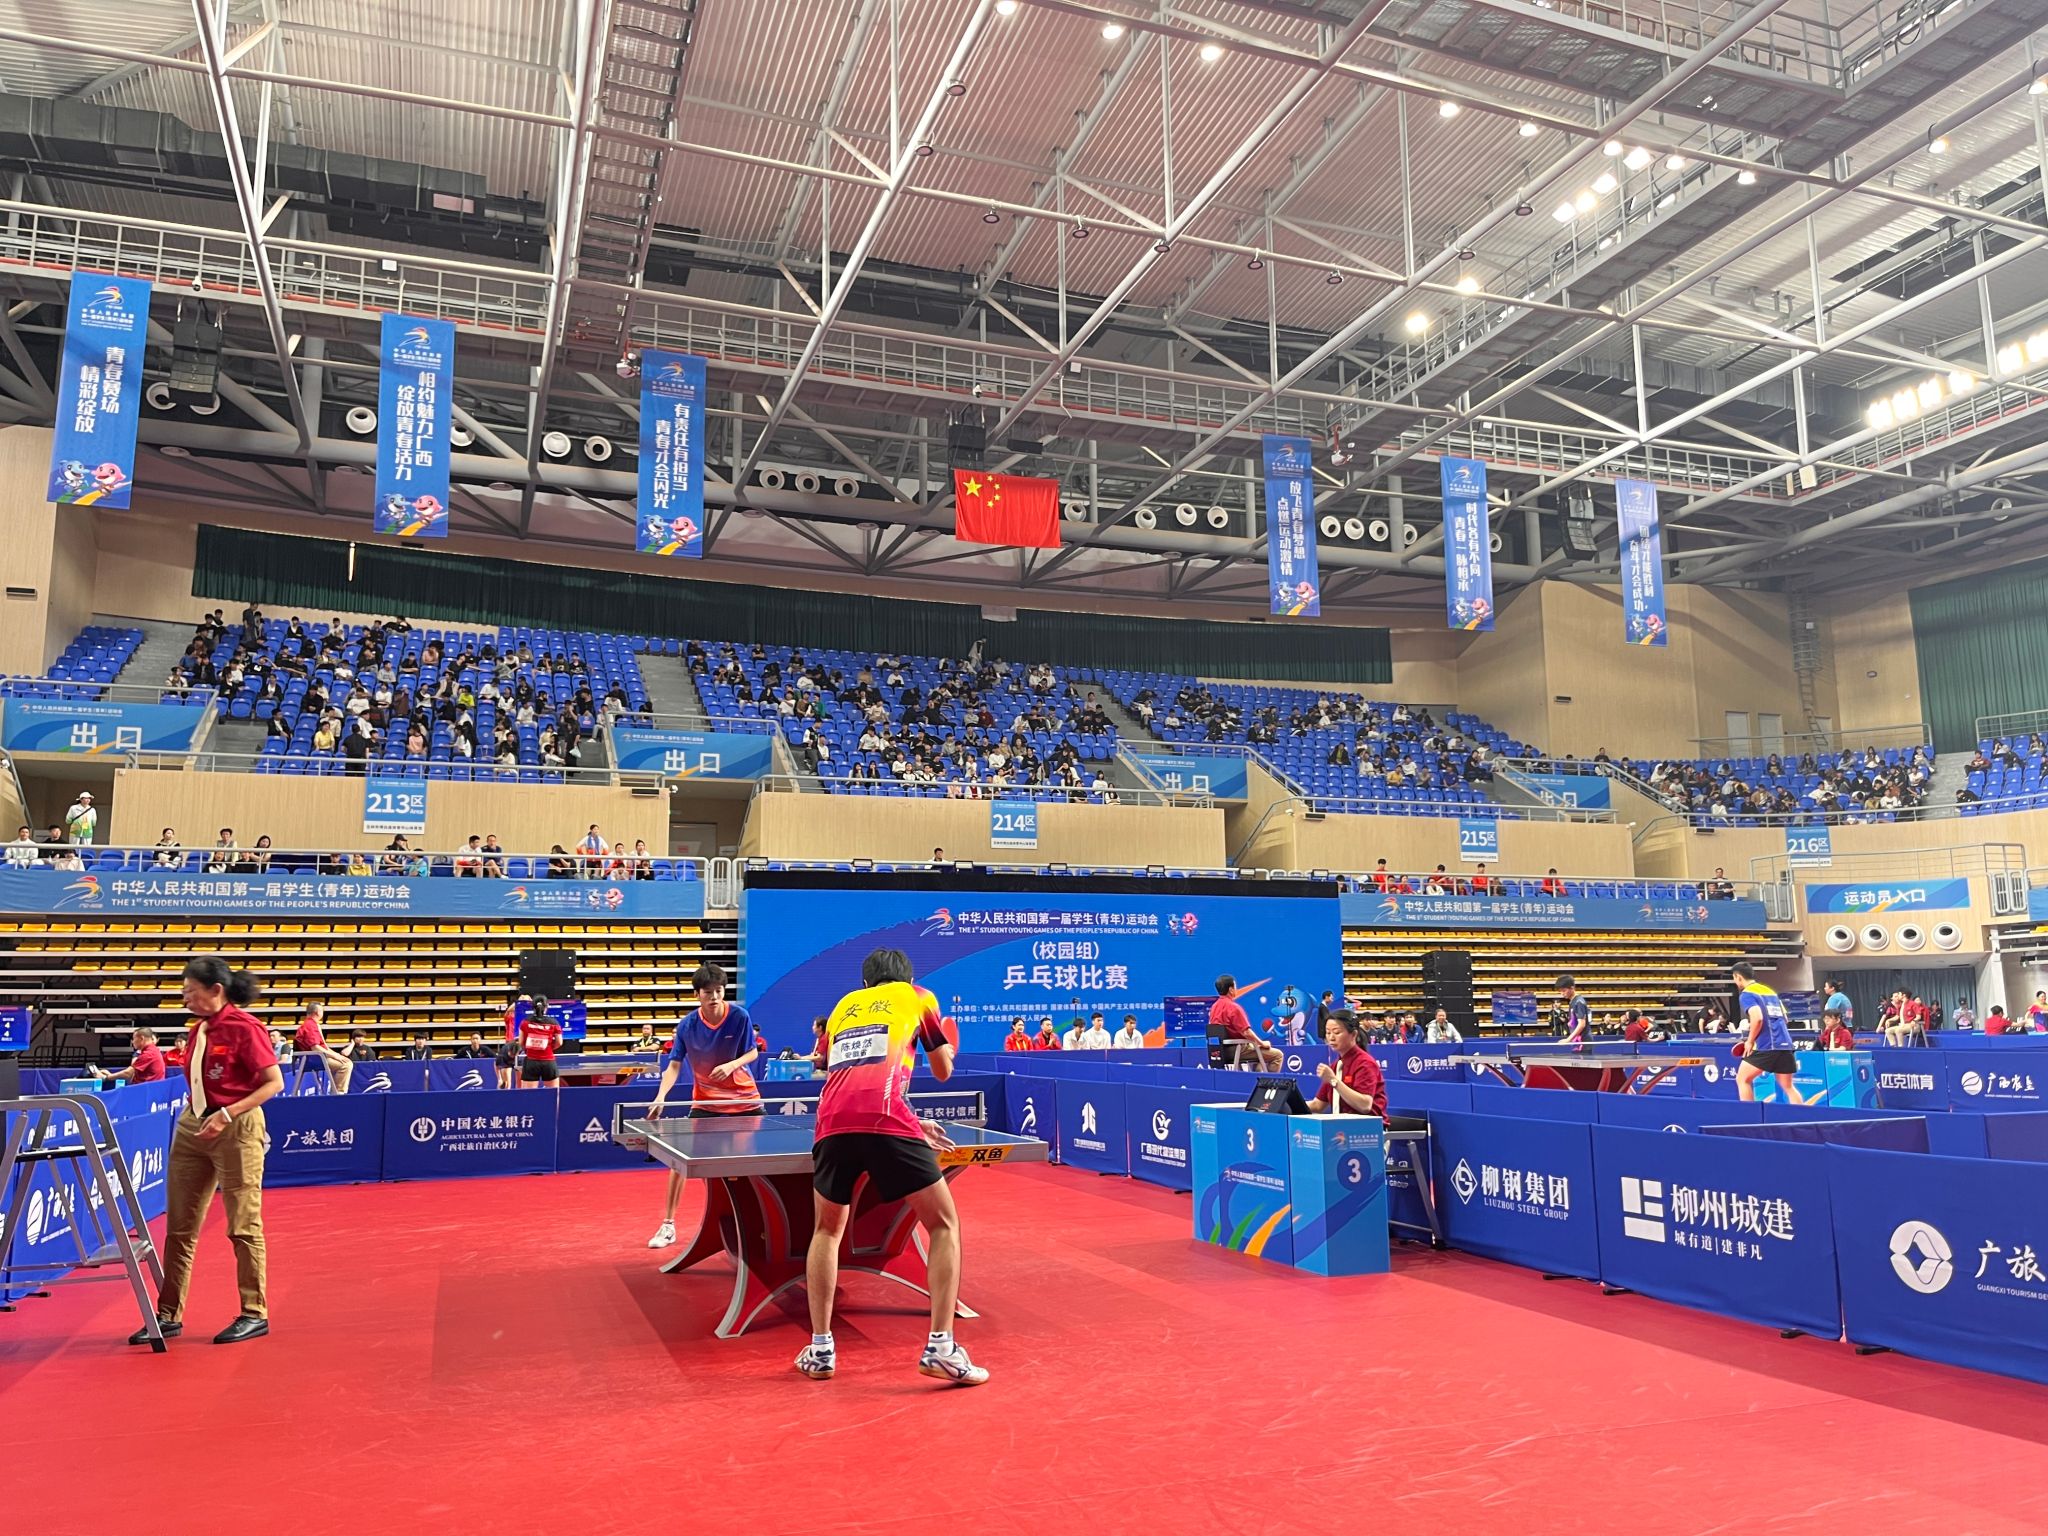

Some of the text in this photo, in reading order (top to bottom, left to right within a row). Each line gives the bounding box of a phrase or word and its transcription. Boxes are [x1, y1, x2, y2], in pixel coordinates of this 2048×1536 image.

[100, 346, 125, 414] 青春赛场
[75, 365, 100, 433] 精彩绽放
[416, 371, 436, 467] 相约魅力广西
[395, 385, 415, 481] 绽放青春活力
[653, 419, 671, 509] 青春才会闪光
[1289, 481, 1305, 559] 放飞青春梦想
[1277, 497, 1292, 576] 点燃运动激情
[1454, 516, 1469, 592] 青春一脉相承
[70, 722, 142, 750] 出口
[664, 749, 720, 773] 出口
[1165, 772, 1209, 792] 出口
[112, 880, 410, 899] 中华人民共和国第一届学生（青年）运动会
[1844, 888, 1926, 905] 运动员入口
[112, 898, 129, 906] THE
[143, 899, 185, 907] STUDENT
[224, 899, 255, 907] GAMES
[255, 900, 266, 908] OF
[269, 900, 285, 908] THE
[329, 901, 369, 909] REPUBLIC
[958, 912, 1158, 925] 中华人民共和国第一届学生（青年）运动会
[1032, 941, 1099, 960] （校园组）
[1003, 964, 1128, 990] 乒乓球比赛
[836, 1000, 893, 1026] 安徽
[1861, 1069, 1866, 1080] 1
[1881, 1073, 1934, 1090] 匹克体育
[441, 1115, 534, 1131] 中国农业银行
[282, 1128, 353, 1149] 广旅集团
[440, 1141, 517, 1151] 广西壮族自治区分行
[580, 1131, 609, 1143] PEAK
[1246, 1128, 1254, 1151] 3
[970, 1148, 1004, 1162] 双鱼
[1348, 1158, 1362, 1183] 3
[1481, 1164, 1569, 1210] 柳钢集团
[1484, 1197, 1569, 1220] LIUZHOU STEEL GROUP
[1670, 1184, 1794, 1240] 柳州城建
[1974, 1239, 2046, 1282] 广旅
[1977, 1283, 2006, 1295] GUANGXI
[2007, 1287, 2037, 1299] TOURISM
